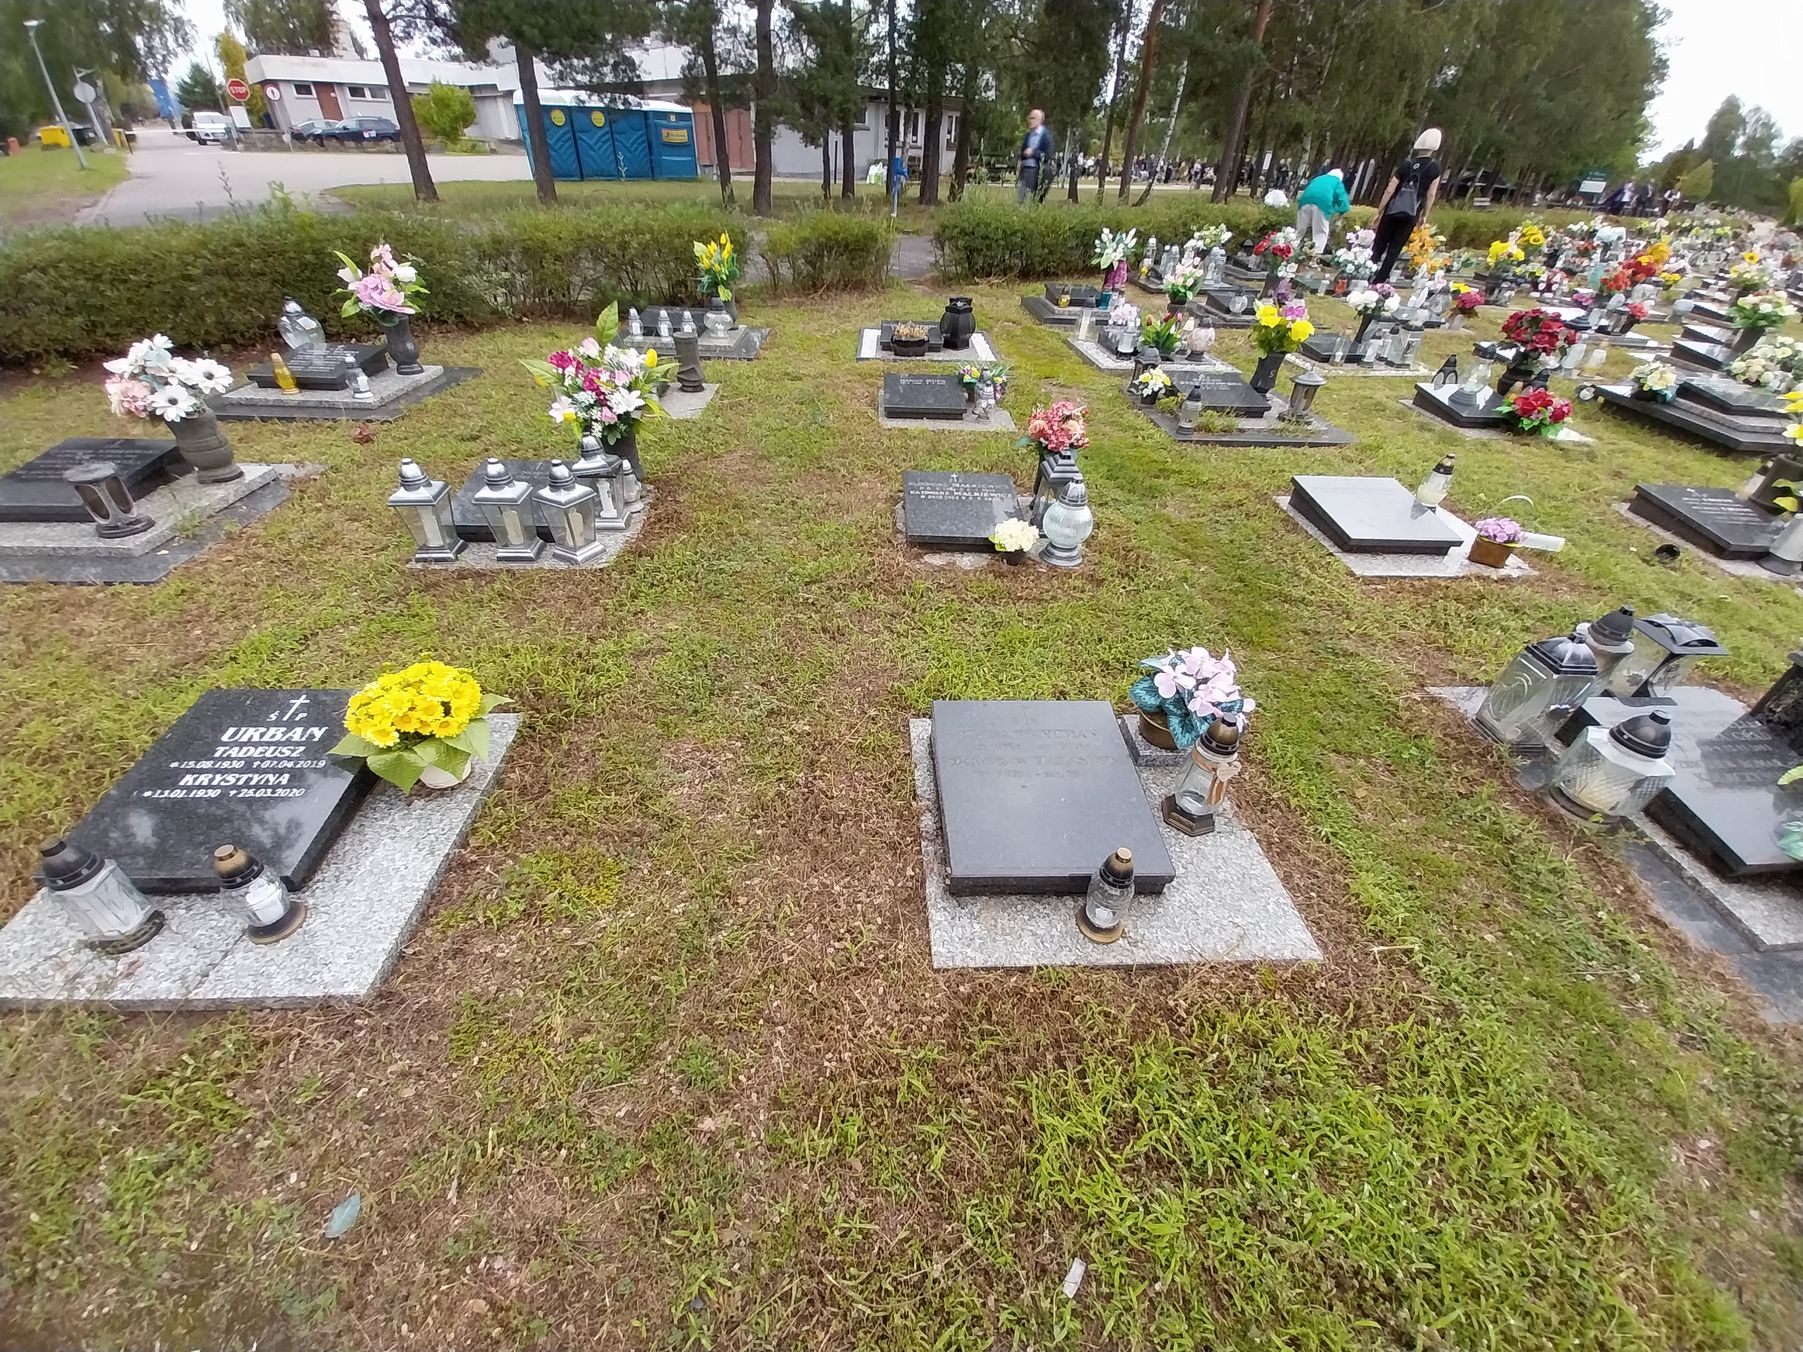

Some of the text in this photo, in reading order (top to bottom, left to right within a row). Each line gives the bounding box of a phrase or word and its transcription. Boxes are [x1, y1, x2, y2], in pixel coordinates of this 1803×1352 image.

[230, 86, 246, 94] STOP
[220, 727, 329, 742] URBAN
[213, 746, 306, 758] TADEUSZ
[179, 760, 246, 769] 15.08.1930
[178, 773, 291, 786] KRYSTYNA
